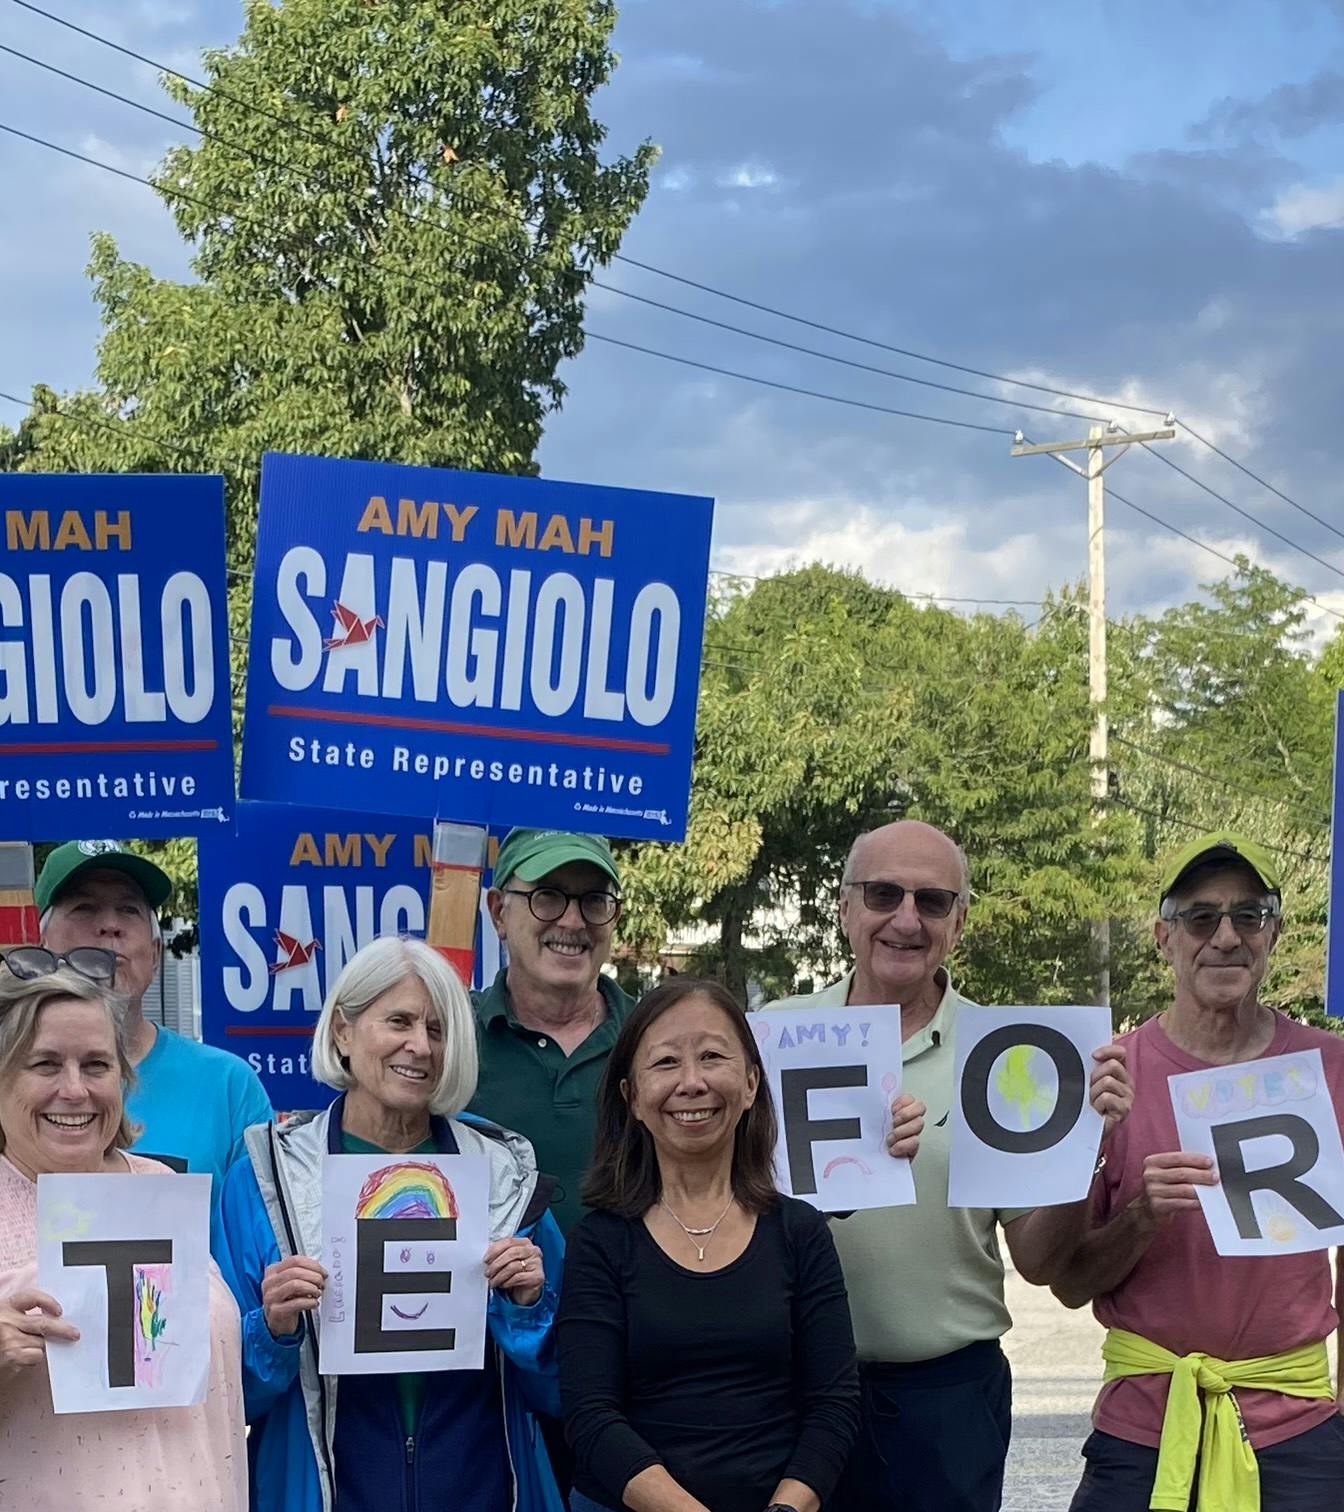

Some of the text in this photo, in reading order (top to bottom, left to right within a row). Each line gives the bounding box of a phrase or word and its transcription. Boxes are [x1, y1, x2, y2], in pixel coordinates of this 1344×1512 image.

[6, 510, 132, 550] MAH
[356, 497, 615, 558] AMY MAH
[271, 545, 681, 727] SANGIOLO
[288, 736, 644, 796] State Representative
[289, 833, 396, 867] AMY
[248, 1052, 308, 1075] Stat
[778, 1022, 871, 1049] AMY!
[959, 1022, 1086, 1155] O
[779, 1063, 869, 1197] F
[61, 1238, 173, 1389] T
[353, 1216, 458, 1355] E
